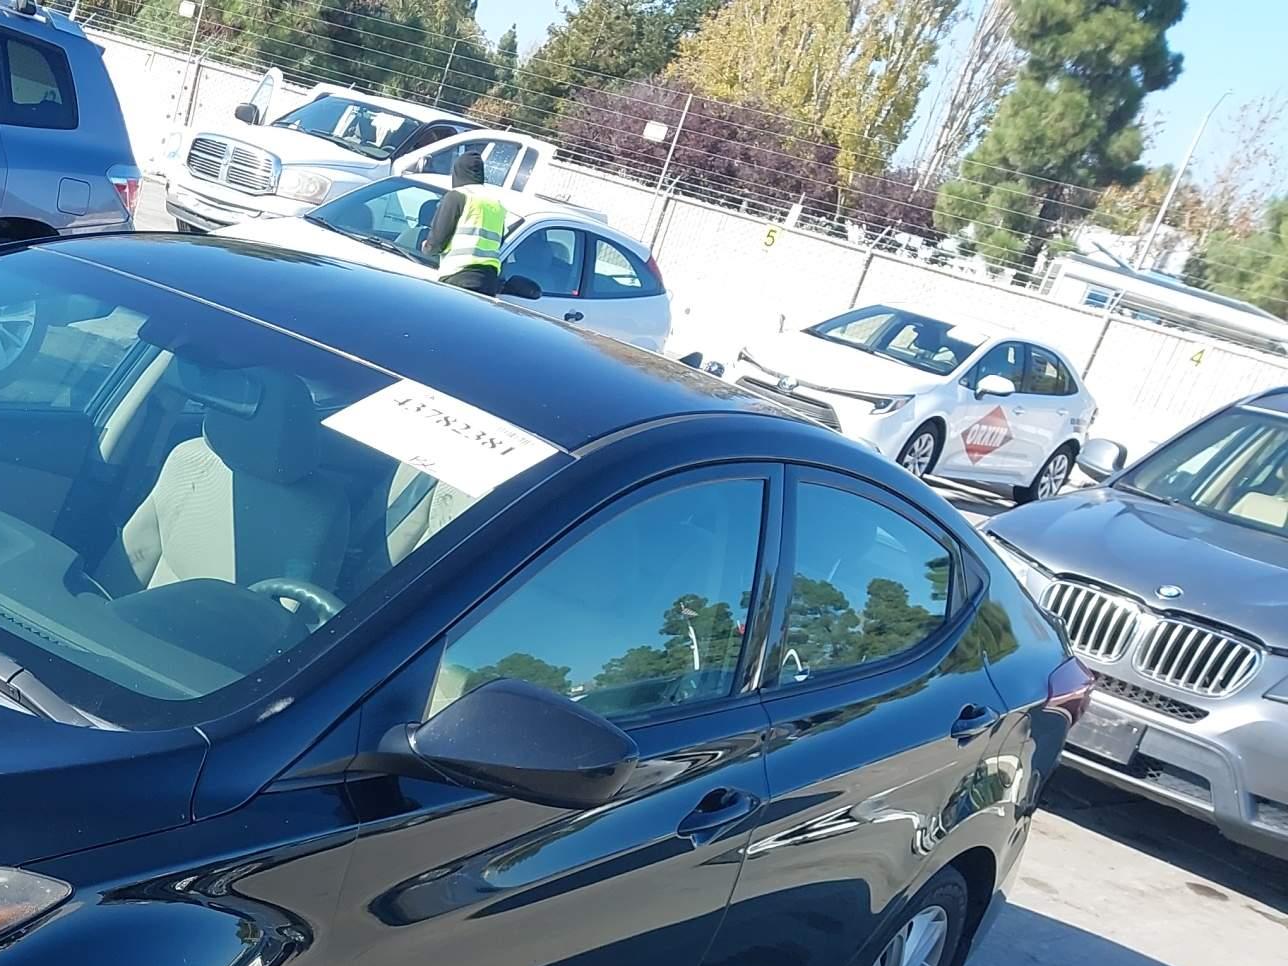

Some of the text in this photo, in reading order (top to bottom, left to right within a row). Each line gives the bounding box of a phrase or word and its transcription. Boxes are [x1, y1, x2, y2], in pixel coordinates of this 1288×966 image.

[764, 228, 778, 247] 5
[1189, 348, 1206, 368] 4
[393, 398, 515, 456] 43782381
[965, 423, 1009, 448] ORKIN
